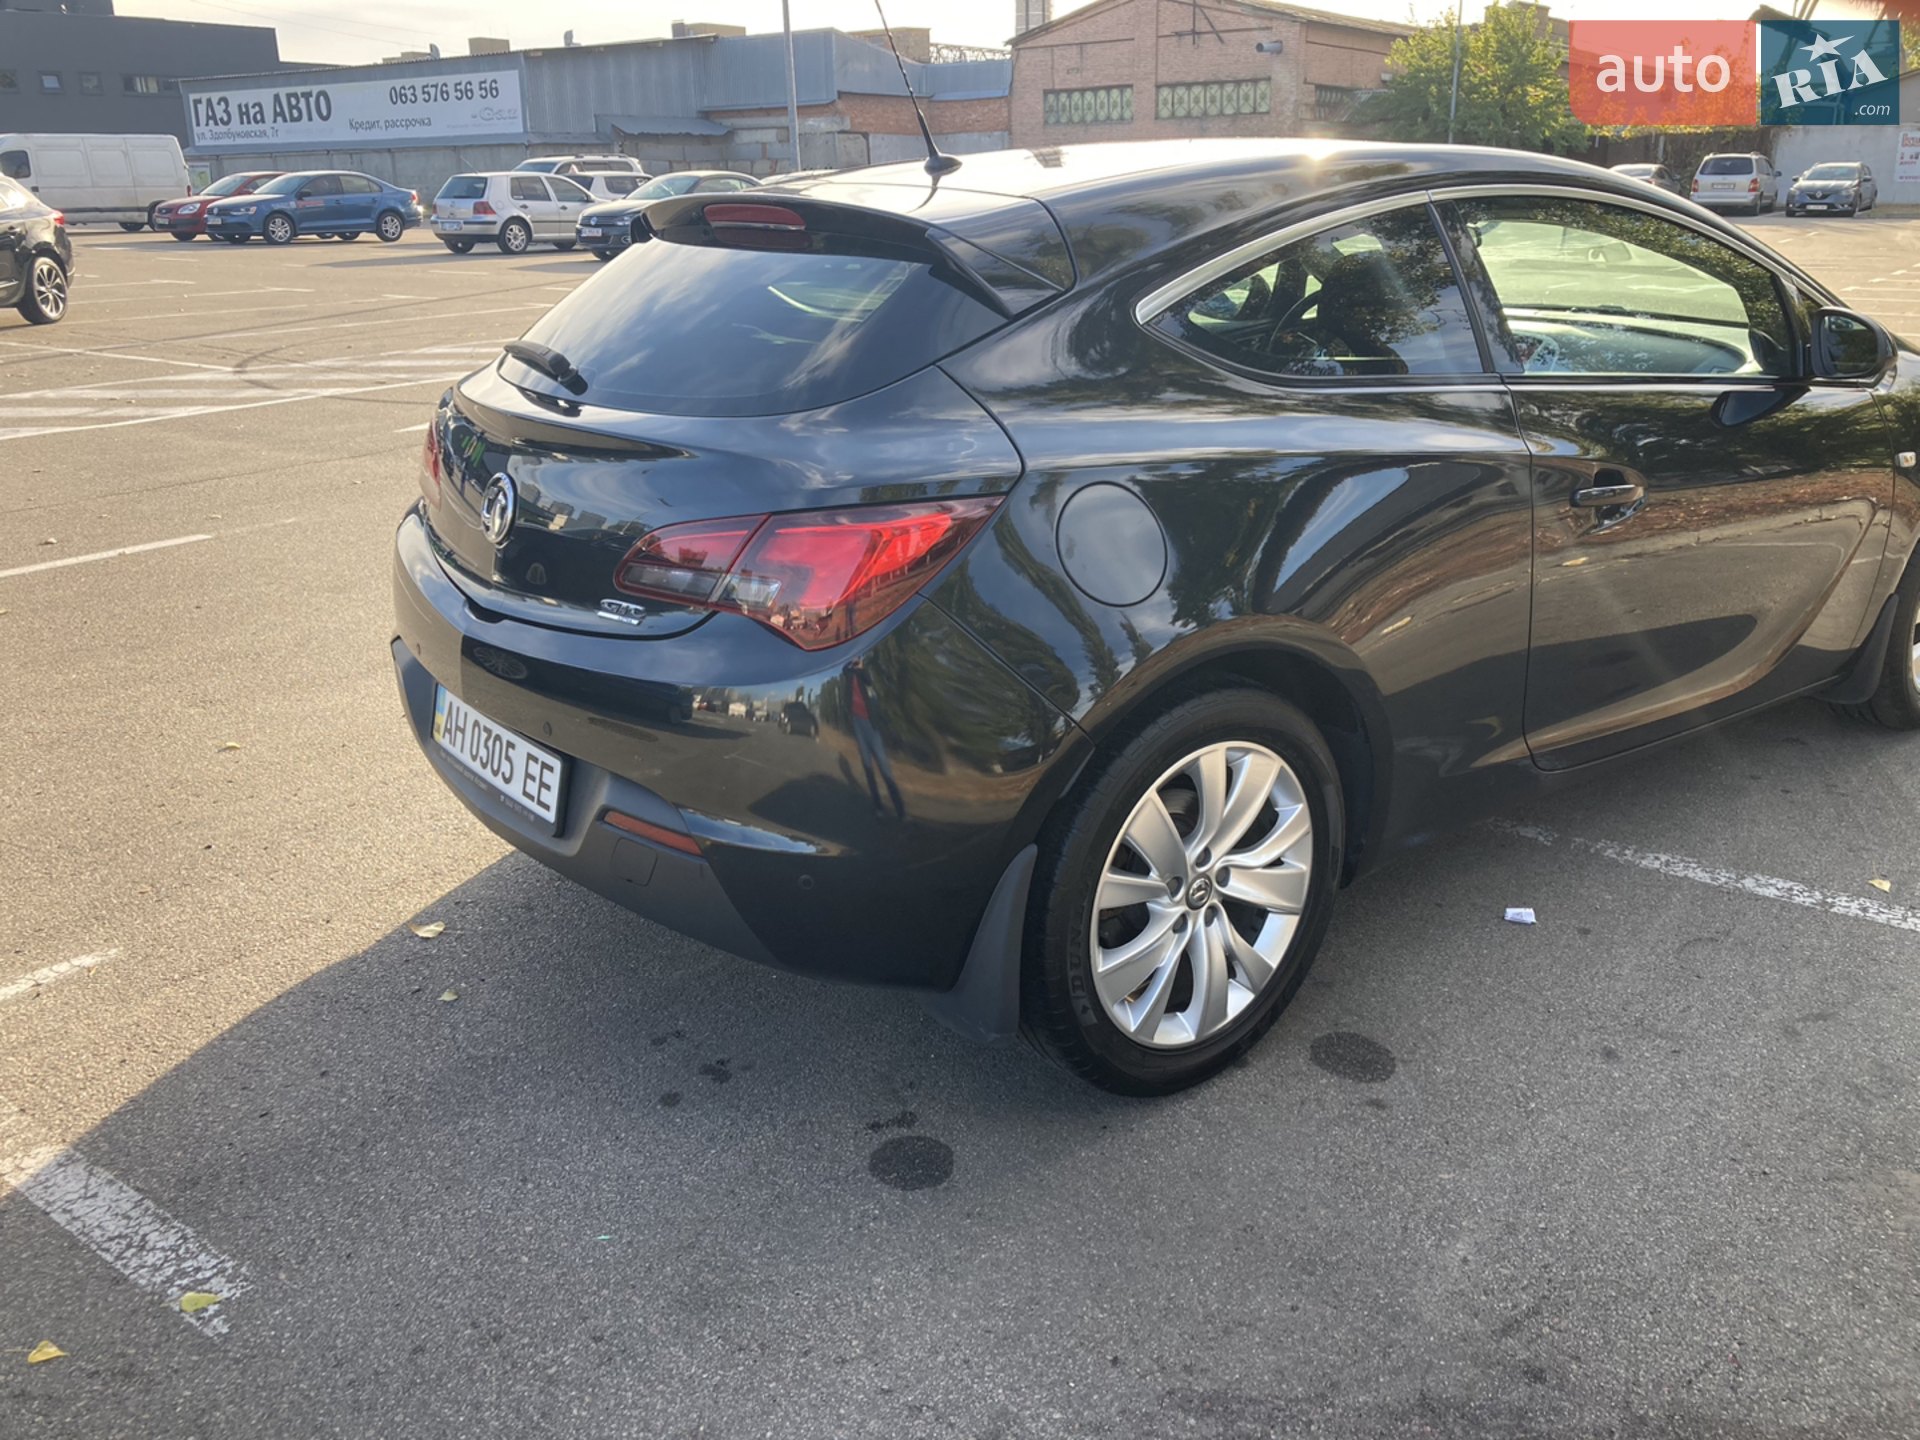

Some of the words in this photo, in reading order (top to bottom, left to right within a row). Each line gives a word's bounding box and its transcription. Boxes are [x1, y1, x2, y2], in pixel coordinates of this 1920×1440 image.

[389, 85, 418, 105] 063
[421, 82, 450, 103] 576
[454, 80, 474, 101] 56
[478, 78, 500, 100] 56
[193, 96, 232, 127] ГАЗ
[237, 101, 266, 126] на
[272, 89, 332, 124] АВТО
[348, 118, 383, 133] Кредит,
[384, 116, 432, 132] рассрочка
[442, 701, 468, 753] AH
[470, 719, 516, 785] 0305
[522, 752, 554, 812] EE
